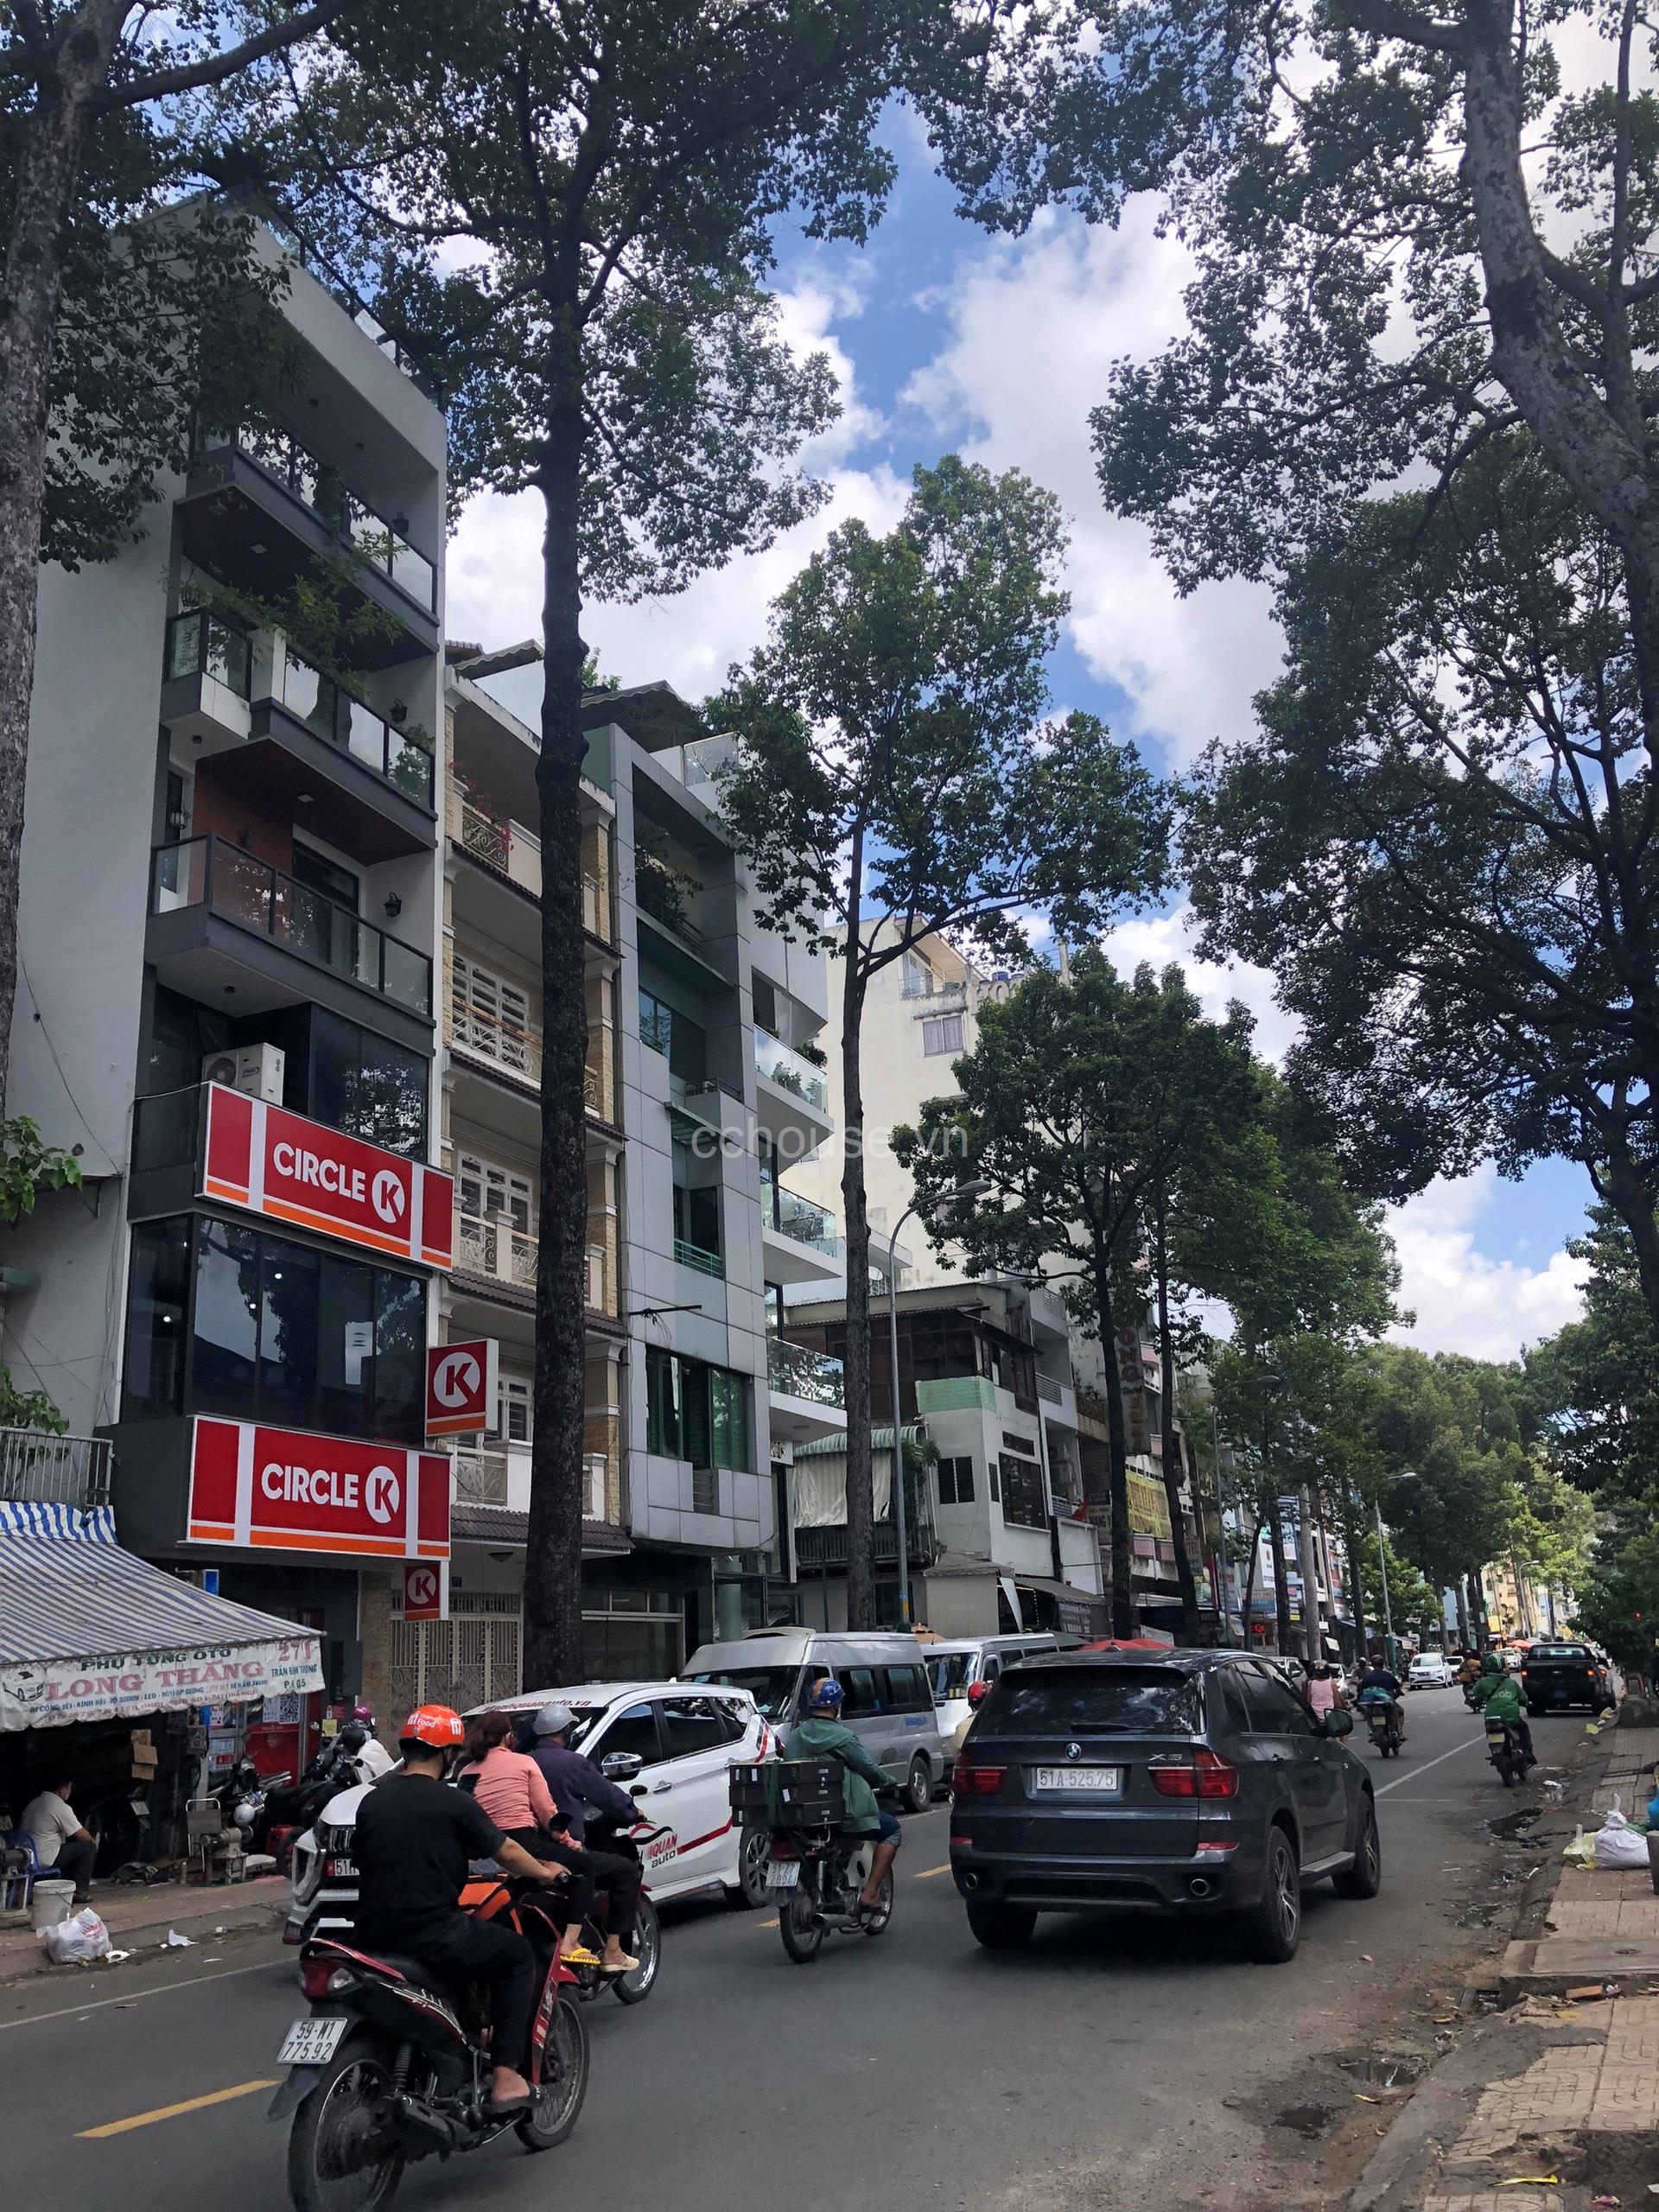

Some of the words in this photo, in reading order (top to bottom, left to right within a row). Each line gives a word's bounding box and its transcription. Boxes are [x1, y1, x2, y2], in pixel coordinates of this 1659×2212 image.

[273, 1142, 366, 1203] CIRCLE
[376, 1174, 404, 1222] K
[438, 1356, 479, 1406] K
[261, 1463, 359, 1508] CIRCLE
[369, 1471, 399, 1523] K
[410, 1571, 436, 1604] K
[45, 1673, 144, 1702] LONG
[417, 1718, 435, 1728] Food
[1147, 1753, 1183, 1762] X5
[1039, 1771, 1114, 1787] 51A-525.75
[652, 1849, 677, 1868] auto
[282, 2041, 334, 2061] 775.92
